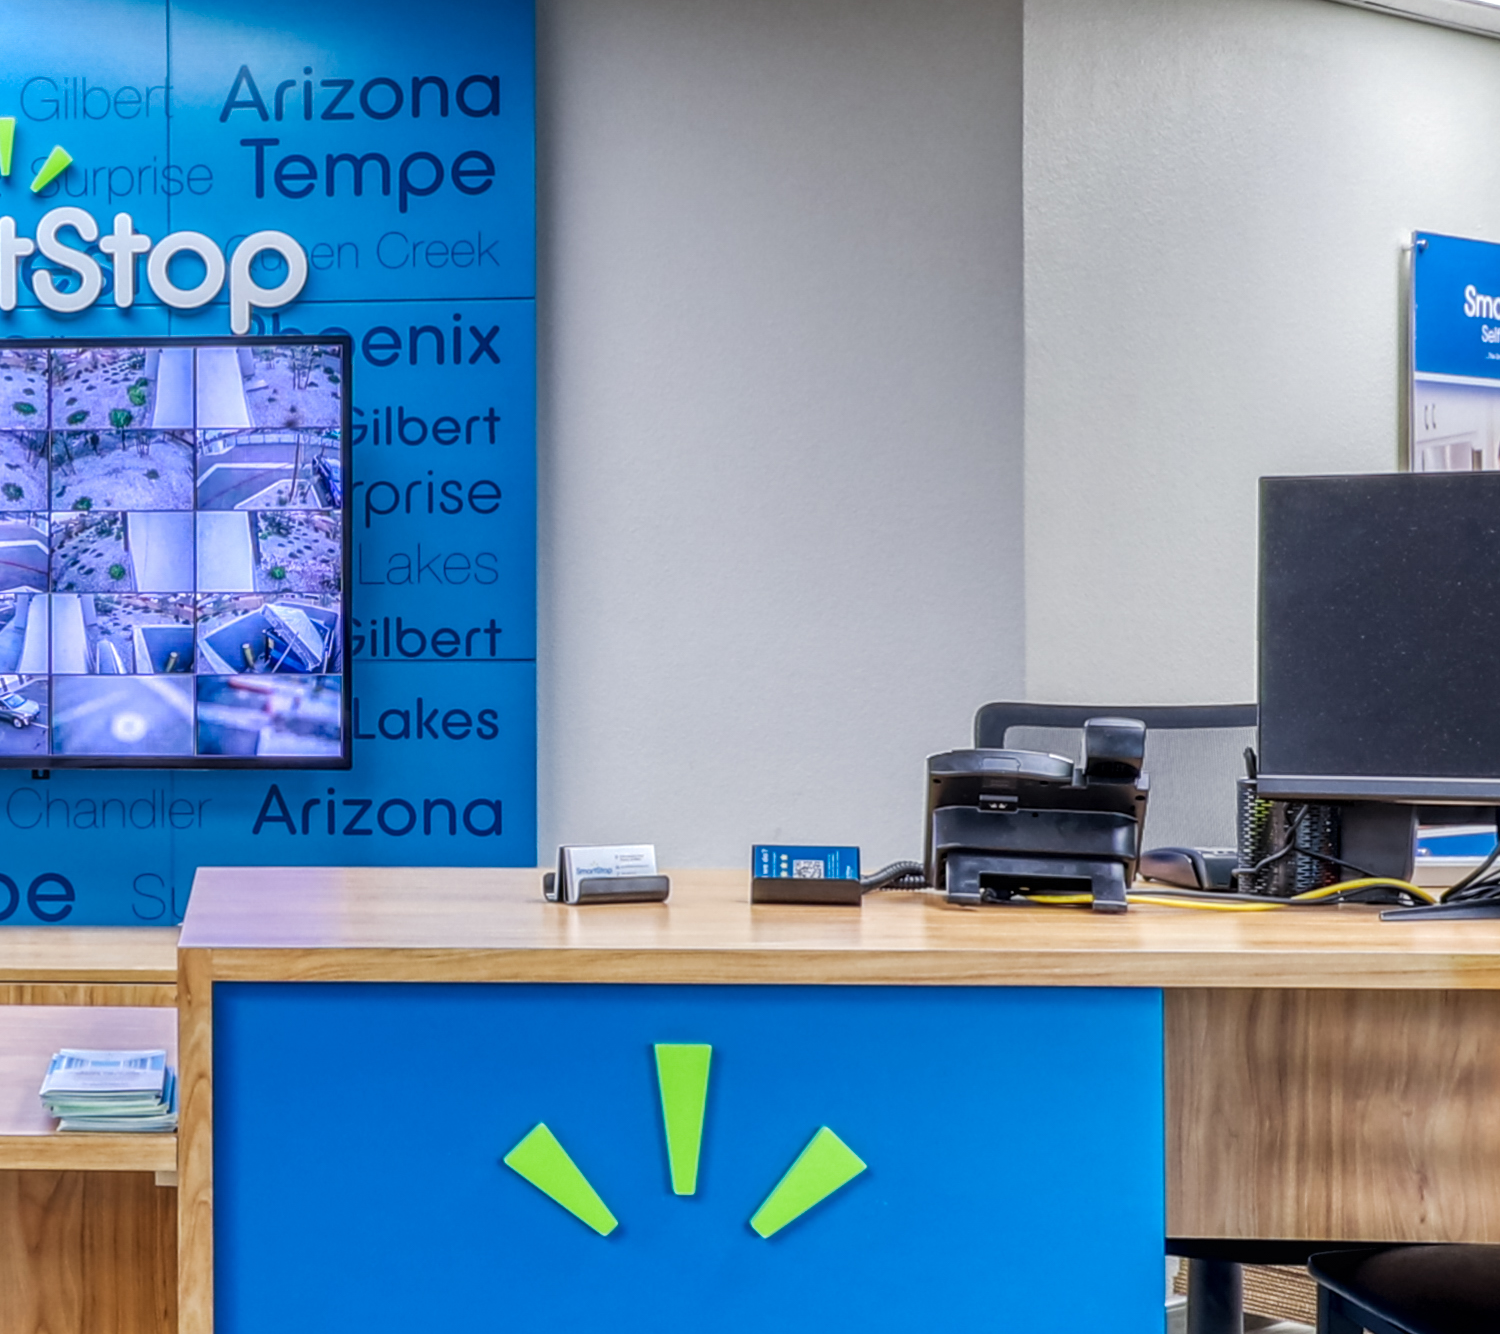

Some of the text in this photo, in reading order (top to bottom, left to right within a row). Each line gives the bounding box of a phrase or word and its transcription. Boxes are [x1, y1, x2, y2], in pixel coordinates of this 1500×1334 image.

[20, 75, 175, 122] Gilbert
[219, 64, 501, 124] Arizona
[240, 137, 497, 213] Tempe
[376, 231, 501, 269] Creek
[357, 541, 500, 587] Lakes
[352, 696, 500, 741] Lakes
[6, 786, 214, 830] Chandler
[252, 783, 503, 837] Arizona
